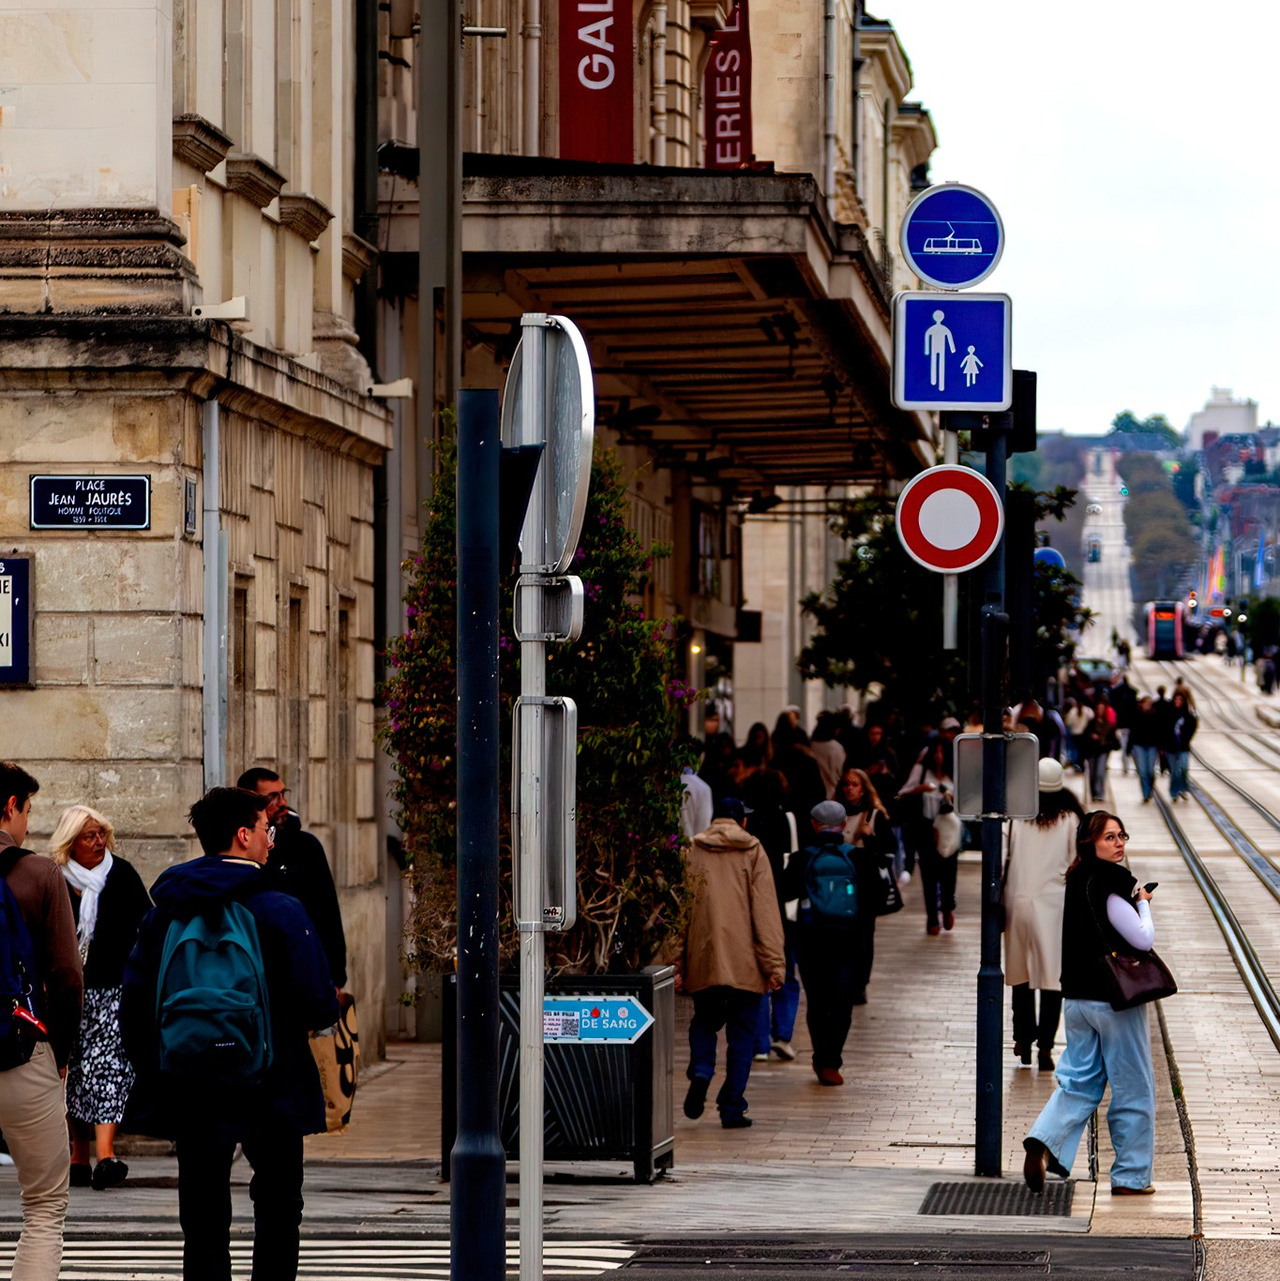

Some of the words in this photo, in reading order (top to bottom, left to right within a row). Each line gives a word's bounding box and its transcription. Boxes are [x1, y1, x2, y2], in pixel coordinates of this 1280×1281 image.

[715, 48, 741, 164] ERIES
[75, 480, 105, 491] PLACE
[48, 492, 76, 506] JEAN
[581, 1019, 598, 1029] DE
[602, 1019, 637, 1029] SANG
